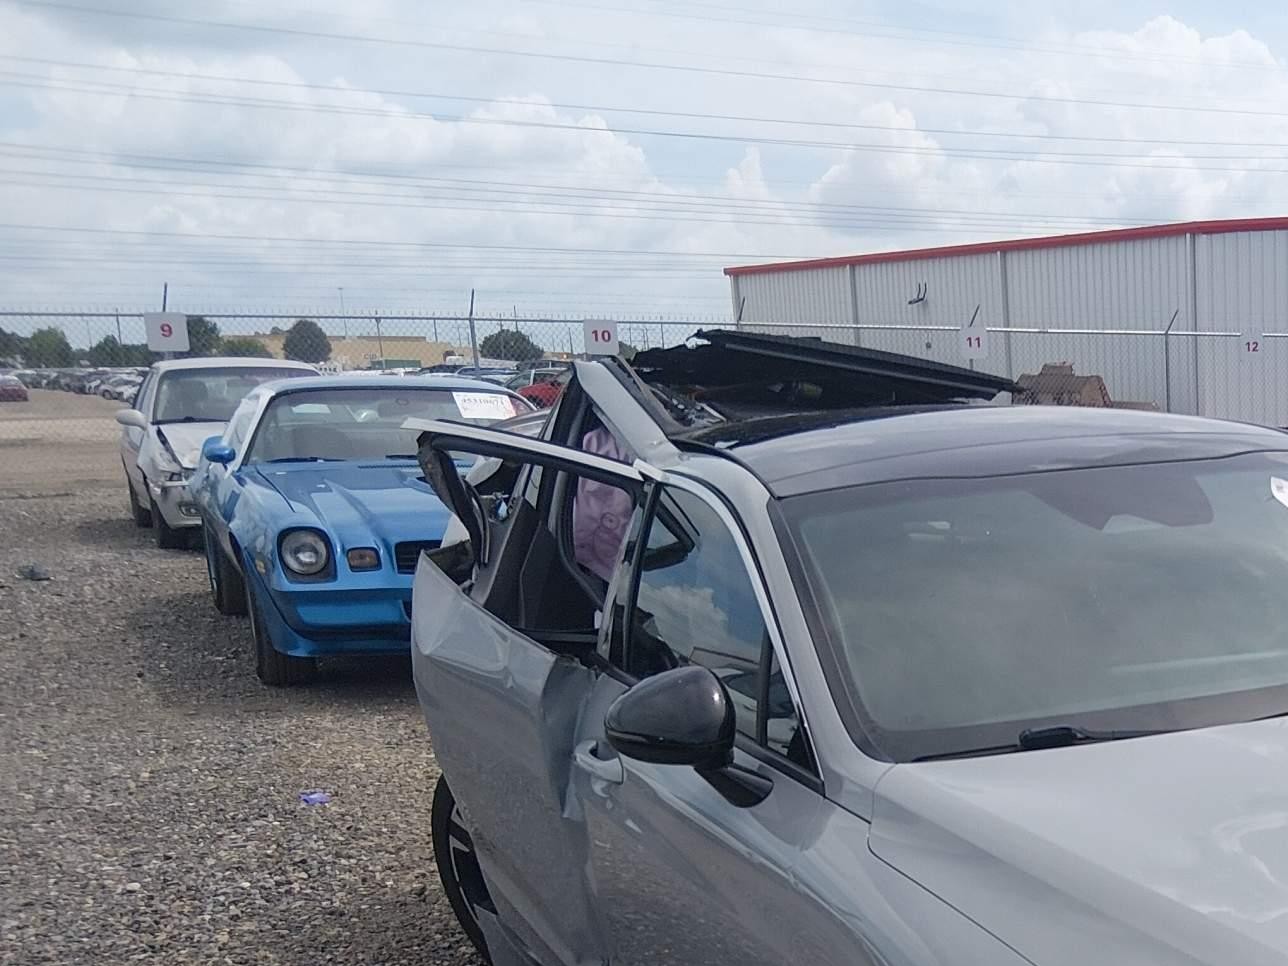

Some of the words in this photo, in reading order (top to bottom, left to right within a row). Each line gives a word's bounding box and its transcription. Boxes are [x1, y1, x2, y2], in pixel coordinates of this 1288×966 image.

[160, 323, 173, 337] 9
[592, 330, 611, 342] 10
[966, 336, 981, 348] 11
[1245, 341, 1259, 352] 12
